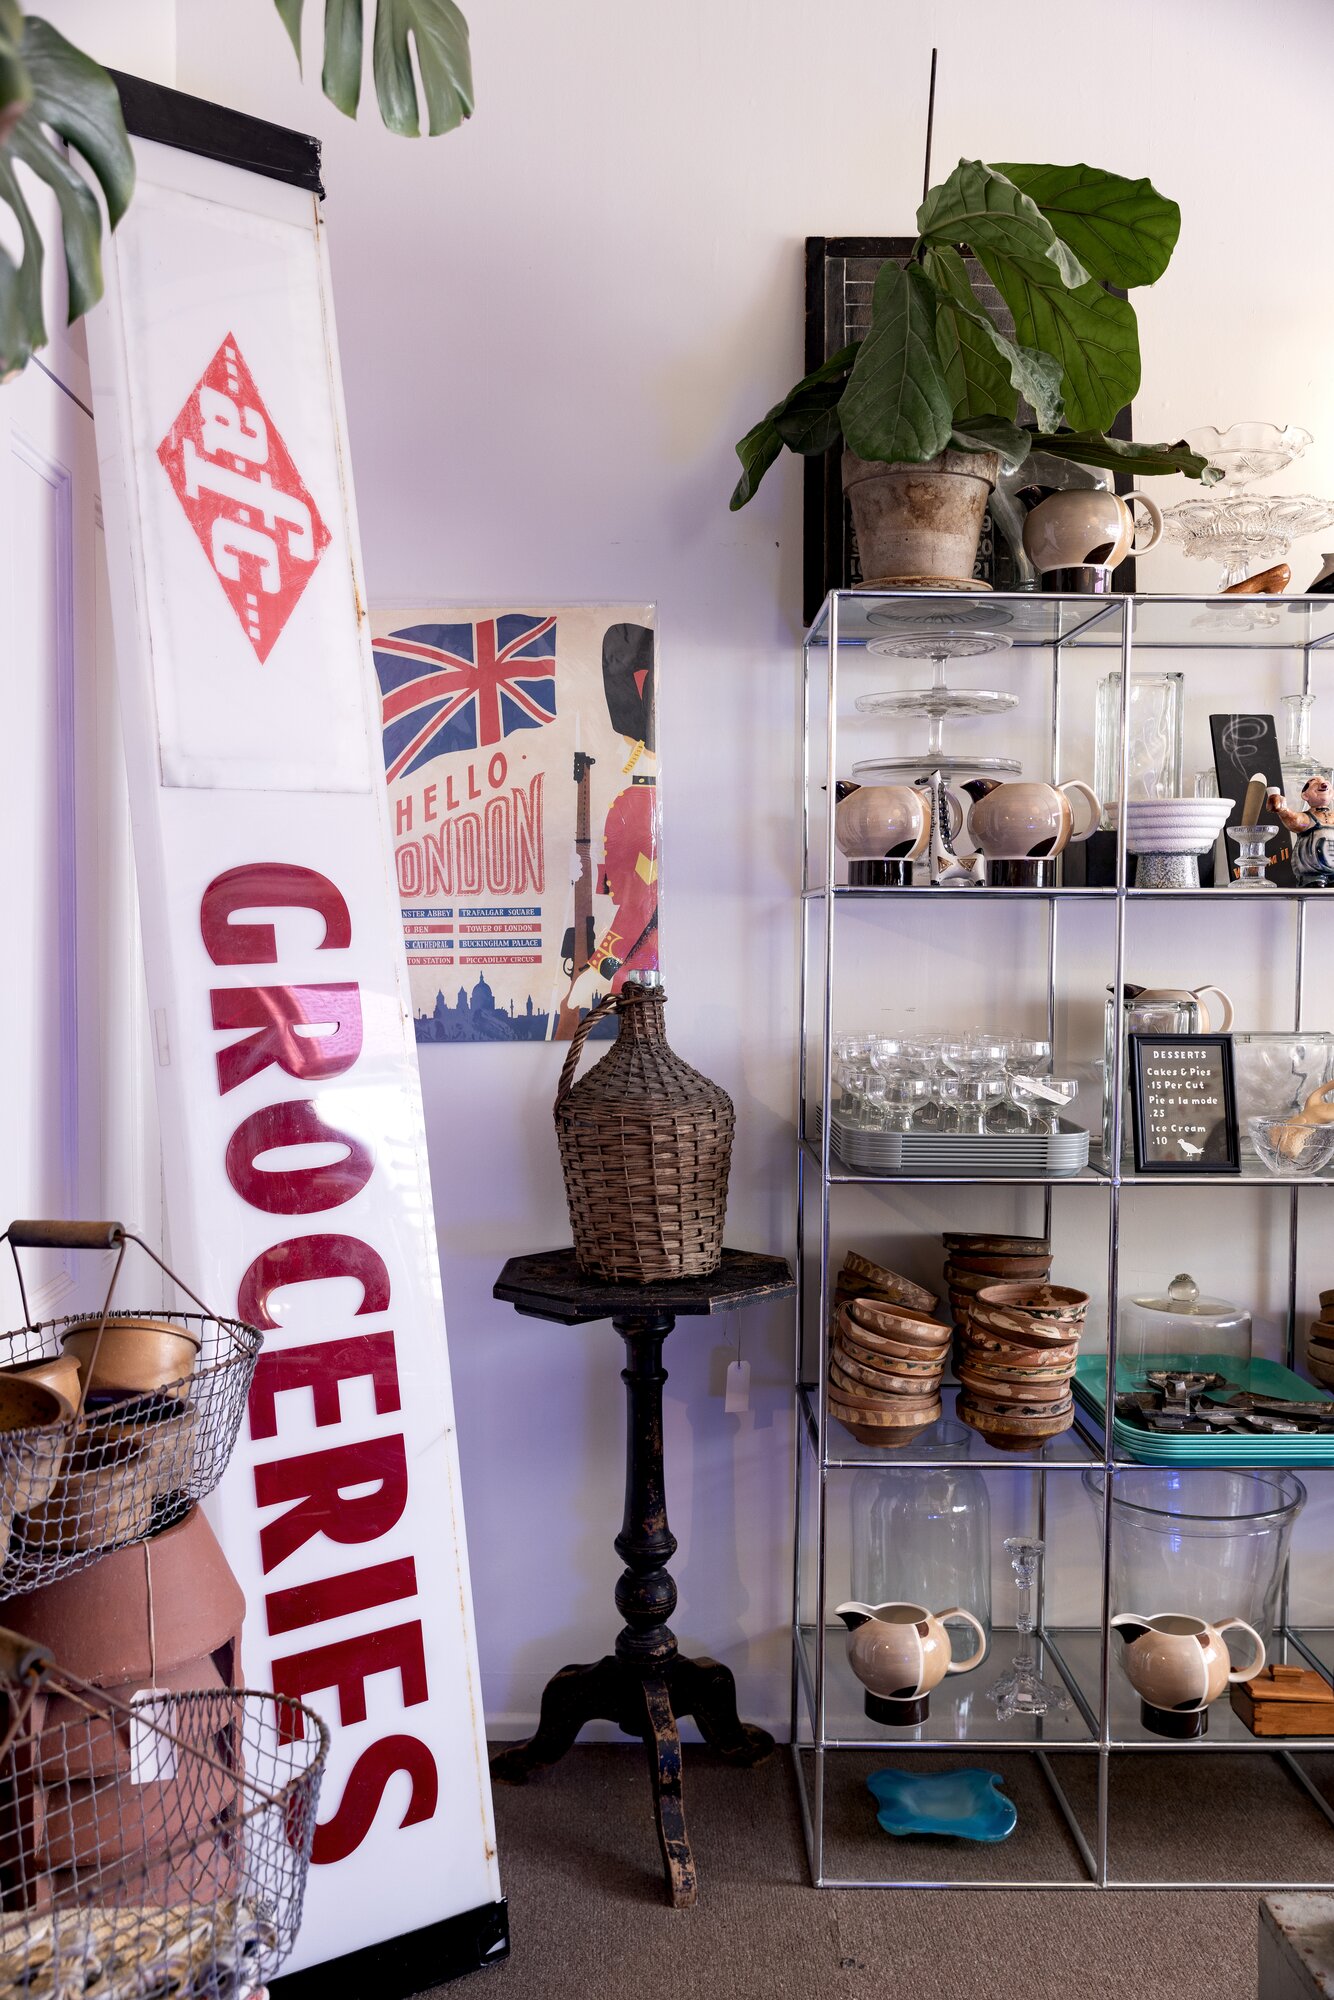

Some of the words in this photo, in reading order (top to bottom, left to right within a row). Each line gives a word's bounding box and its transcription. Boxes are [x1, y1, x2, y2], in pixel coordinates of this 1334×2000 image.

[396, 752, 507, 836] HELLO
[395, 771, 545, 898] ONDON
[508, 908, 535, 916] SQUARE
[504, 924, 533, 932] LONDON
[1147, 1068, 1177, 1076] Cakes
[1181, 1068, 1187, 1076] &
[1190, 1066, 1211, 1076] Pies
[1165, 1081, 1182, 1089] Per
[1186, 1081, 1204, 1089] Cut
[1149, 1095, 1165, 1104] Pie
[1192, 1096, 1218, 1104] mode
[1151, 1124, 1167, 1132] Ice
[1171, 1124, 1206, 1132] Cream
[199, 860, 439, 1867] GROCERIES
